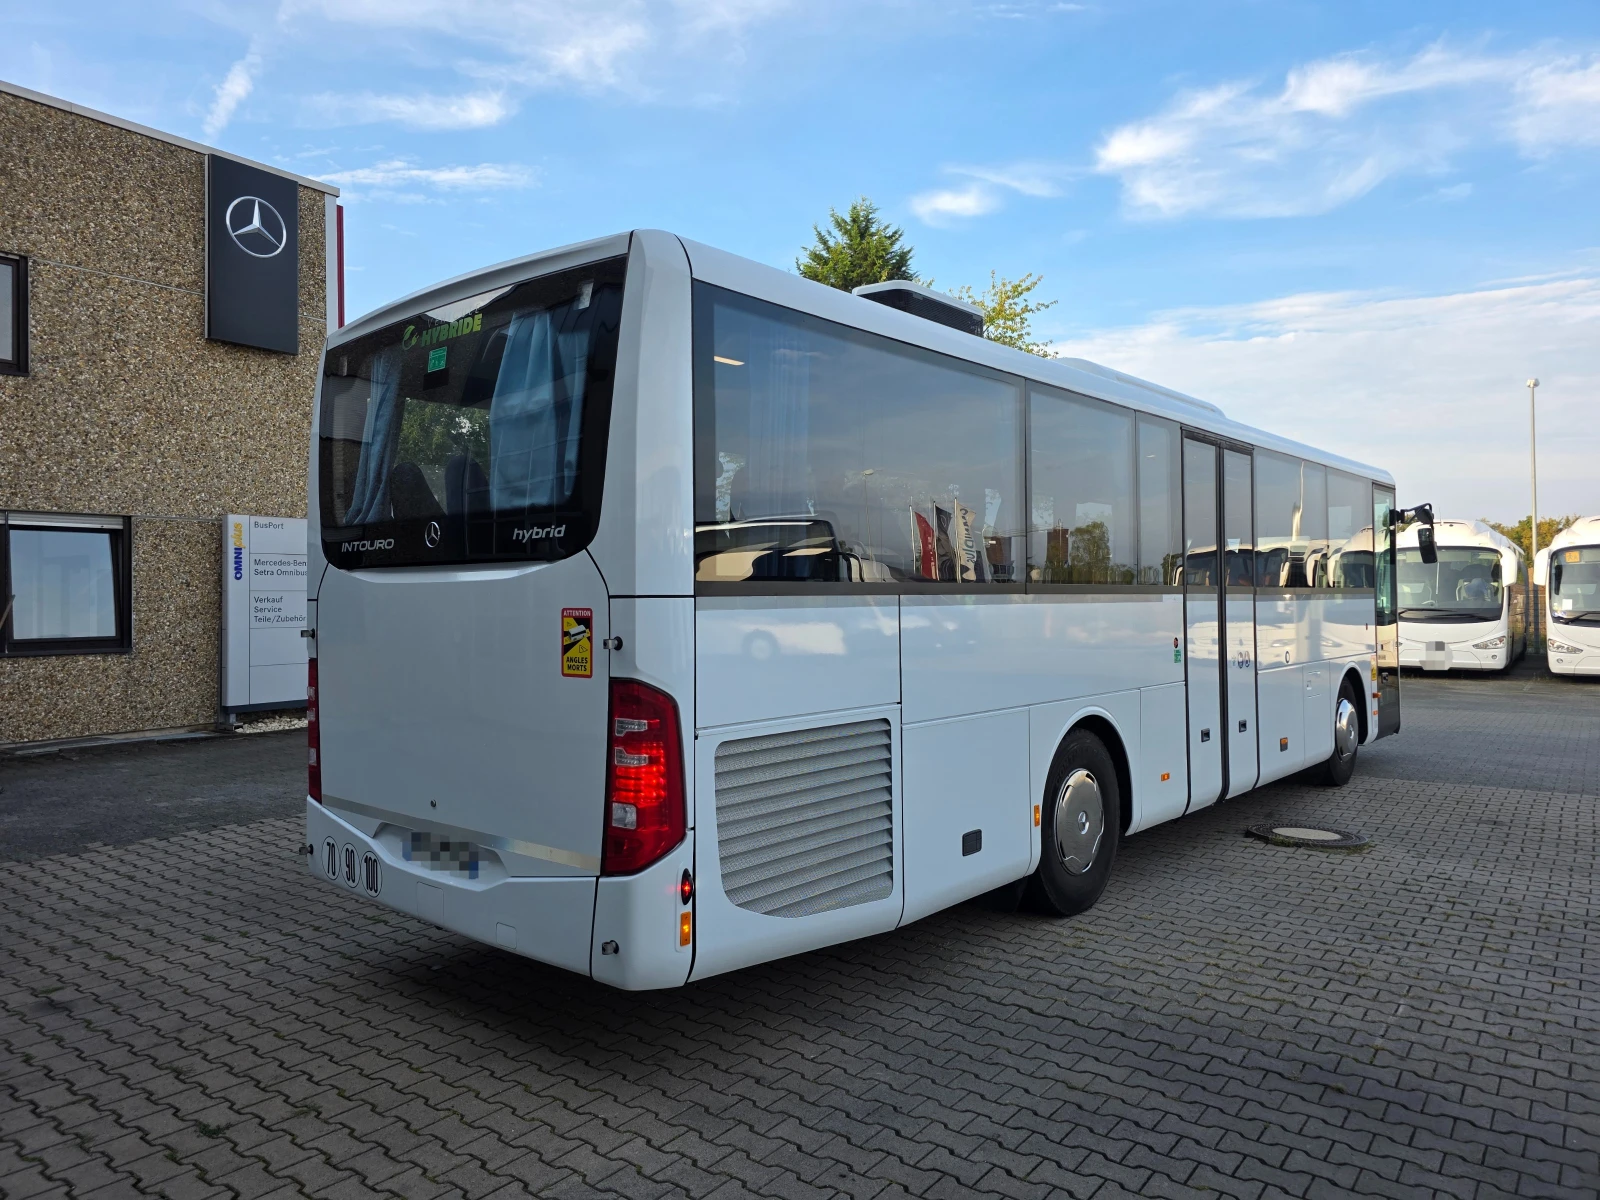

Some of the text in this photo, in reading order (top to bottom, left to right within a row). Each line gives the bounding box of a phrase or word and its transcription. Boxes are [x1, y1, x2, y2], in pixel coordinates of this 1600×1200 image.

[421, 313, 482, 347] HYBRIDE
[254, 521, 284, 529] BusPort
[512, 524, 566, 543] hybrid
[231, 522, 246, 580] OMNIplus
[341, 538, 394, 552] INTOURO
[254, 596, 284, 604] Verkauf
[566, 656, 588, 664] ANGLES
[567, 664, 587, 672] MORTS
[326, 841, 336, 877] 70
[345, 847, 356, 884] 90
[364, 855, 378, 894] 100
